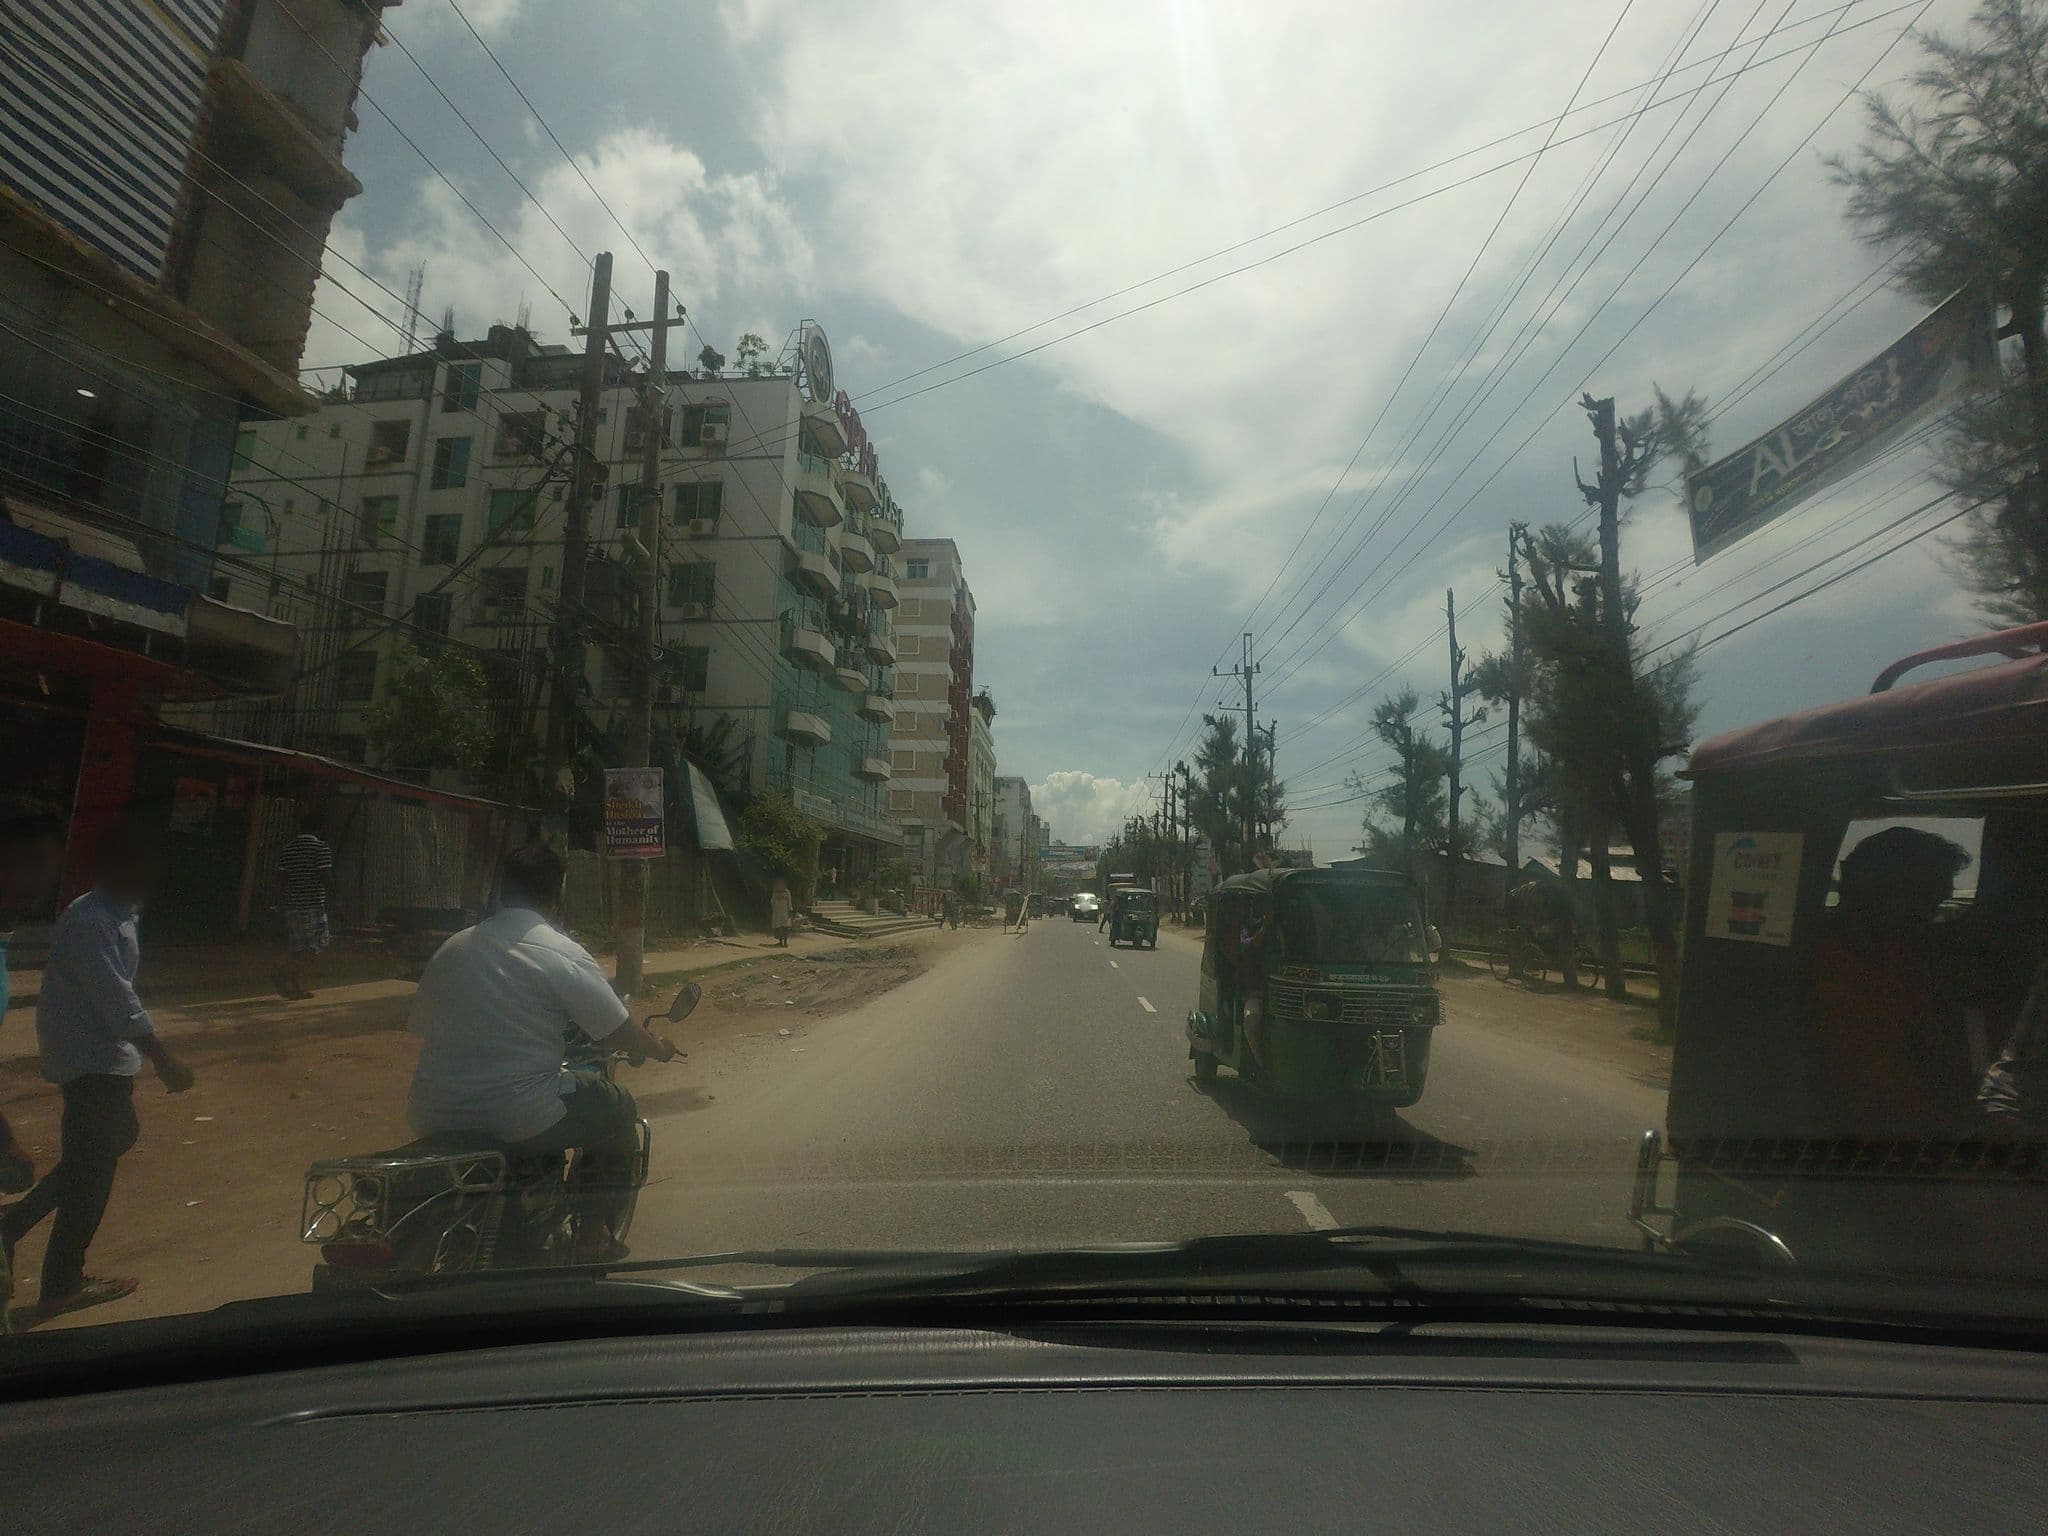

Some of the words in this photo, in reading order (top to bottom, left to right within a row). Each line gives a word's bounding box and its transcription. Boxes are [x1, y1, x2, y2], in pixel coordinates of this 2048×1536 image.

[607, 826, 646, 835] Mother
[647, 824, 659, 835] of
[607, 835, 658, 846] Humanity
